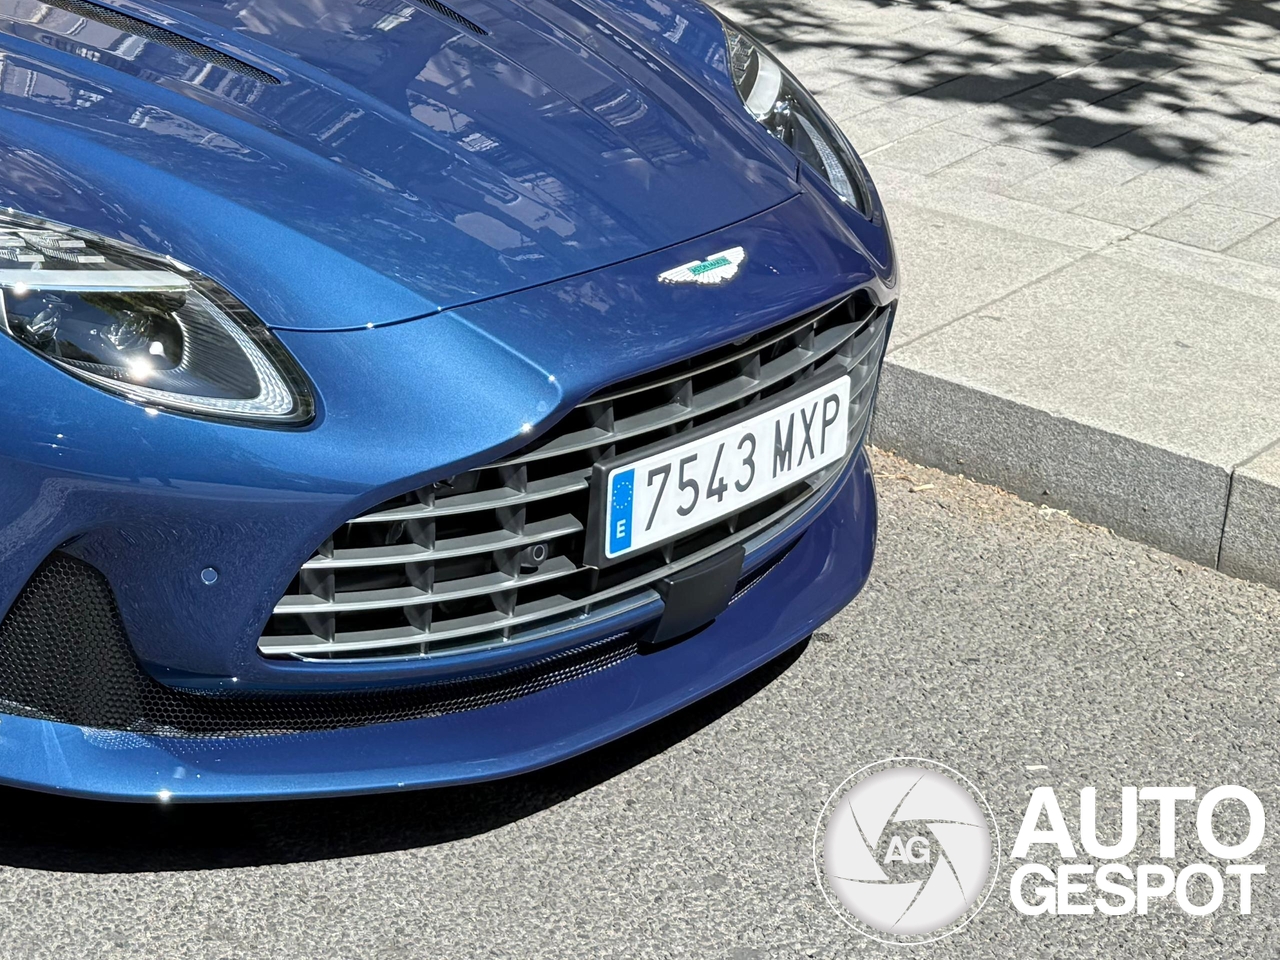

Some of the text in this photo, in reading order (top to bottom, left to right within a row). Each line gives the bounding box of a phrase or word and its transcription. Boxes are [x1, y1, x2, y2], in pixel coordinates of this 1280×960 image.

[644, 392, 841, 533] 7543 MXP
[615, 518, 627, 539] E
